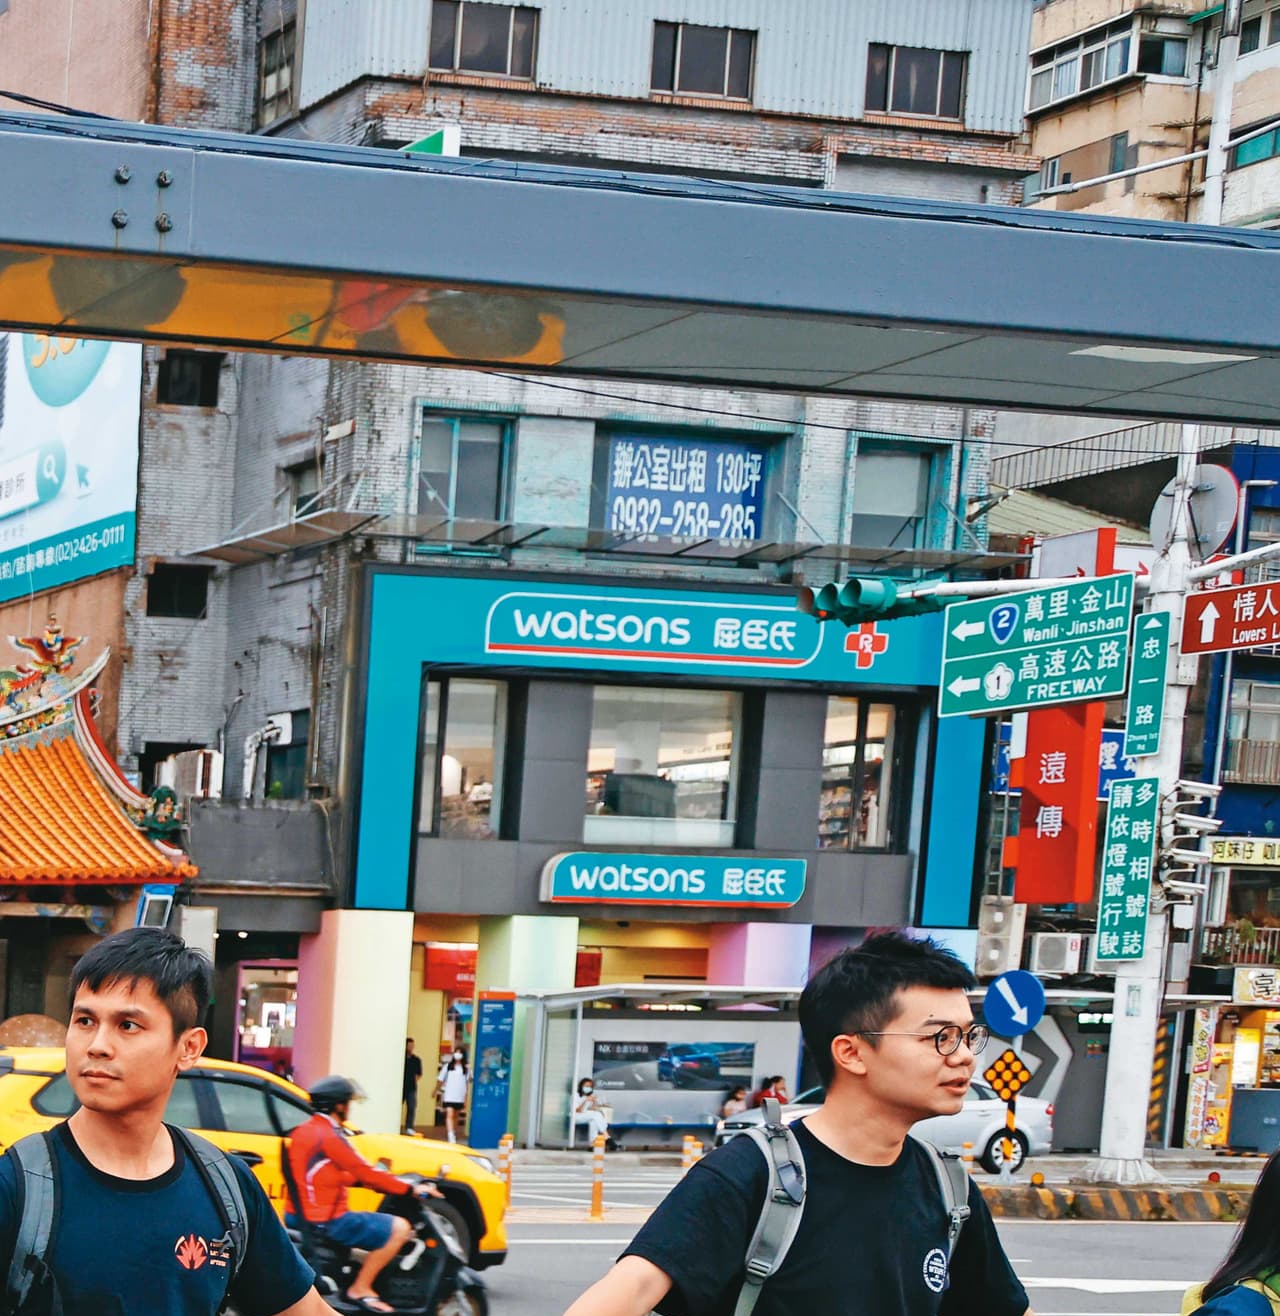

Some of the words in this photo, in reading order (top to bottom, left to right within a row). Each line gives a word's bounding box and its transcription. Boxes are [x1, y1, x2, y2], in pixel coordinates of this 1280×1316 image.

[613, 442, 706, 494] 辦公室出租
[716, 452, 763, 499] 130坪
[611, 500, 757, 548] 0932-258-285
[997, 612, 1011, 630] 2
[1233, 588, 1280, 623] 情人
[513, 608, 692, 647] watsons
[713, 616, 797, 652] 屈臣氏
[1232, 627, 1268, 645] Lovers
[1271, 622, 1280, 640] L
[1018, 640, 1122, 683] 高速公路
[1135, 637, 1161, 726] 忠一路
[1026, 674, 1107, 701] FREEWAY
[1035, 750, 1068, 840] 遠傳
[569, 862, 707, 894] watsons
[722, 866, 787, 897] 屈臣氏
[1098, 785, 1133, 957] 請依燈號行駛
[1121, 782, 1156, 956] 多時相號誌
